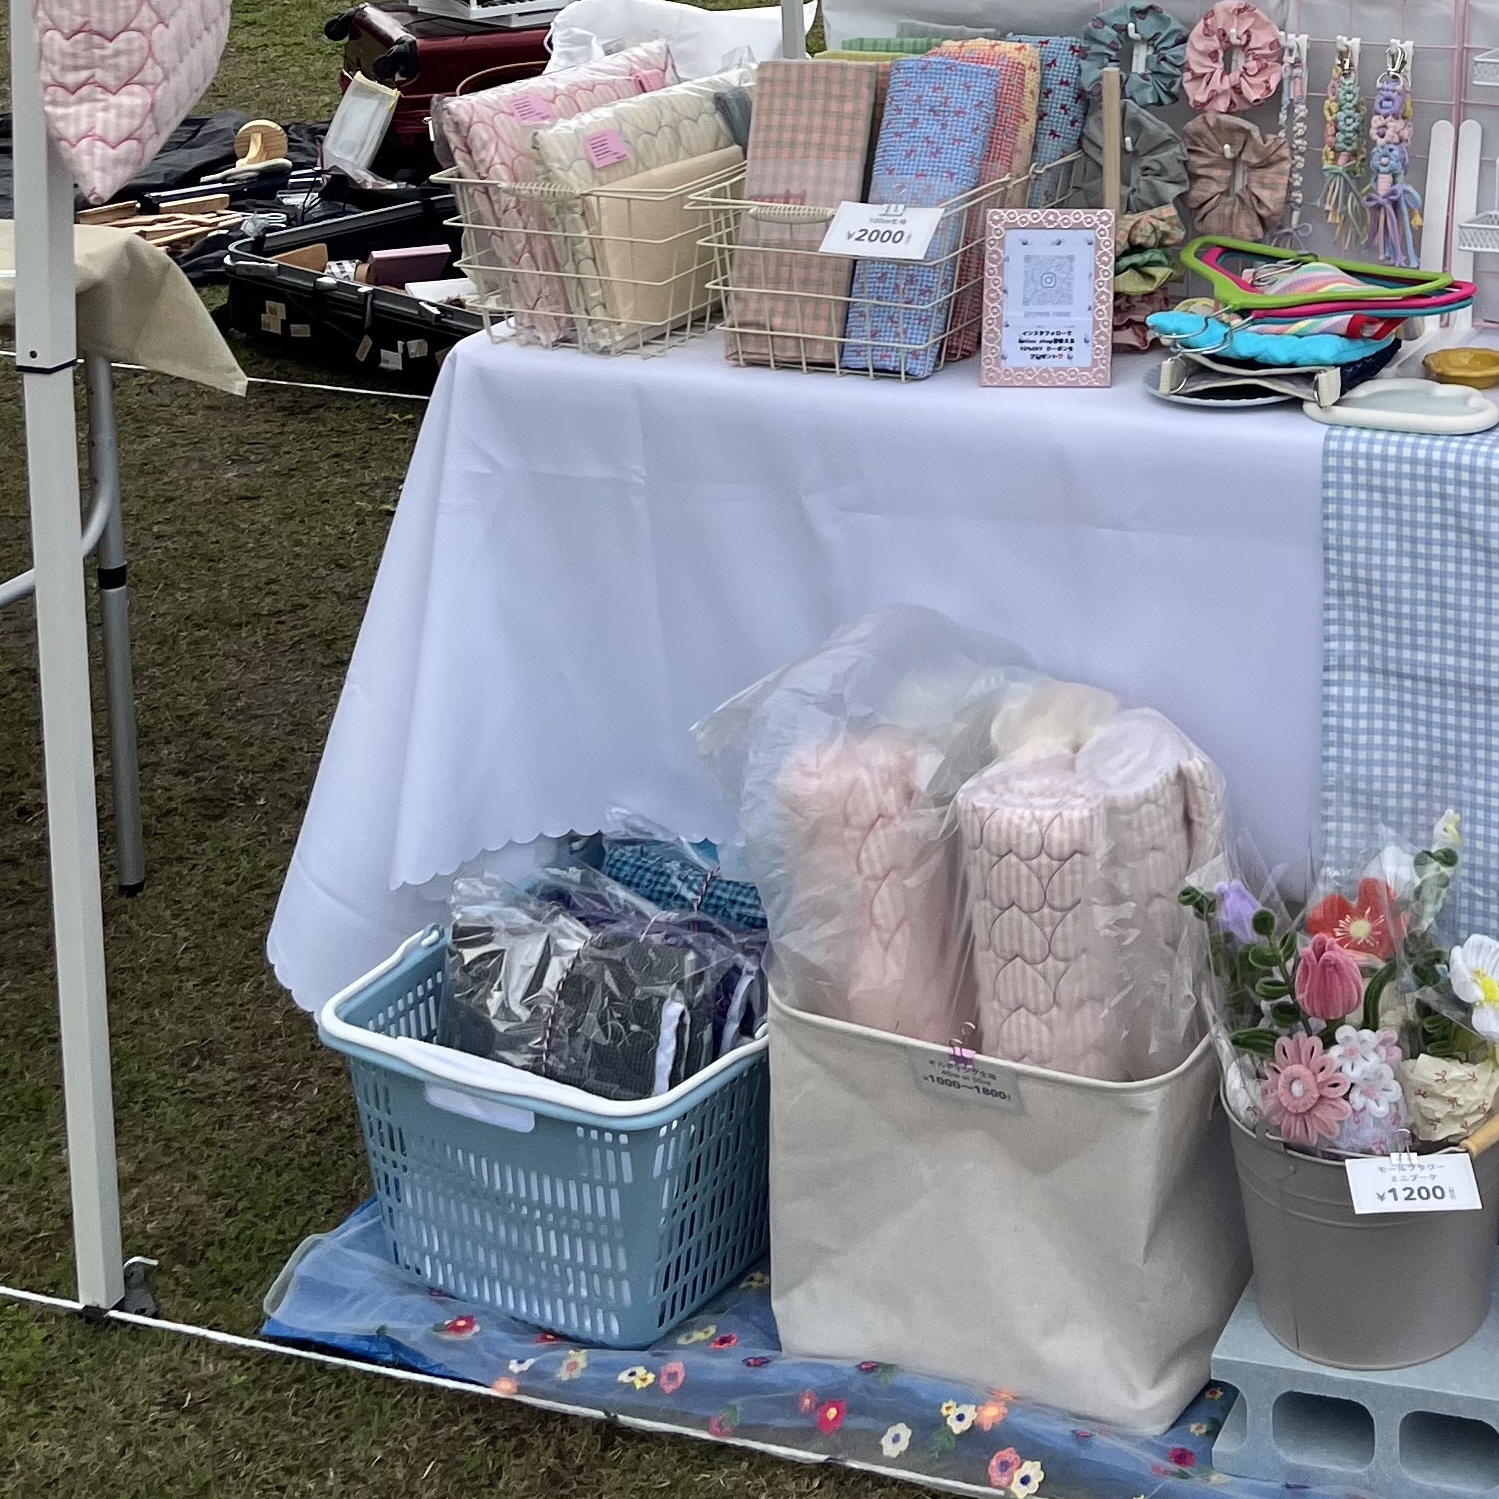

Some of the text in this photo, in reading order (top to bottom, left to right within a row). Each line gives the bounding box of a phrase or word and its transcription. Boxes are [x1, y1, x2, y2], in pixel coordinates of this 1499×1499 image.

[846, 228, 905, 244] ¥2000
[1378, 1163, 1445, 1173] モールフラワー
[1376, 1185, 1446, 1202] ¥1200
